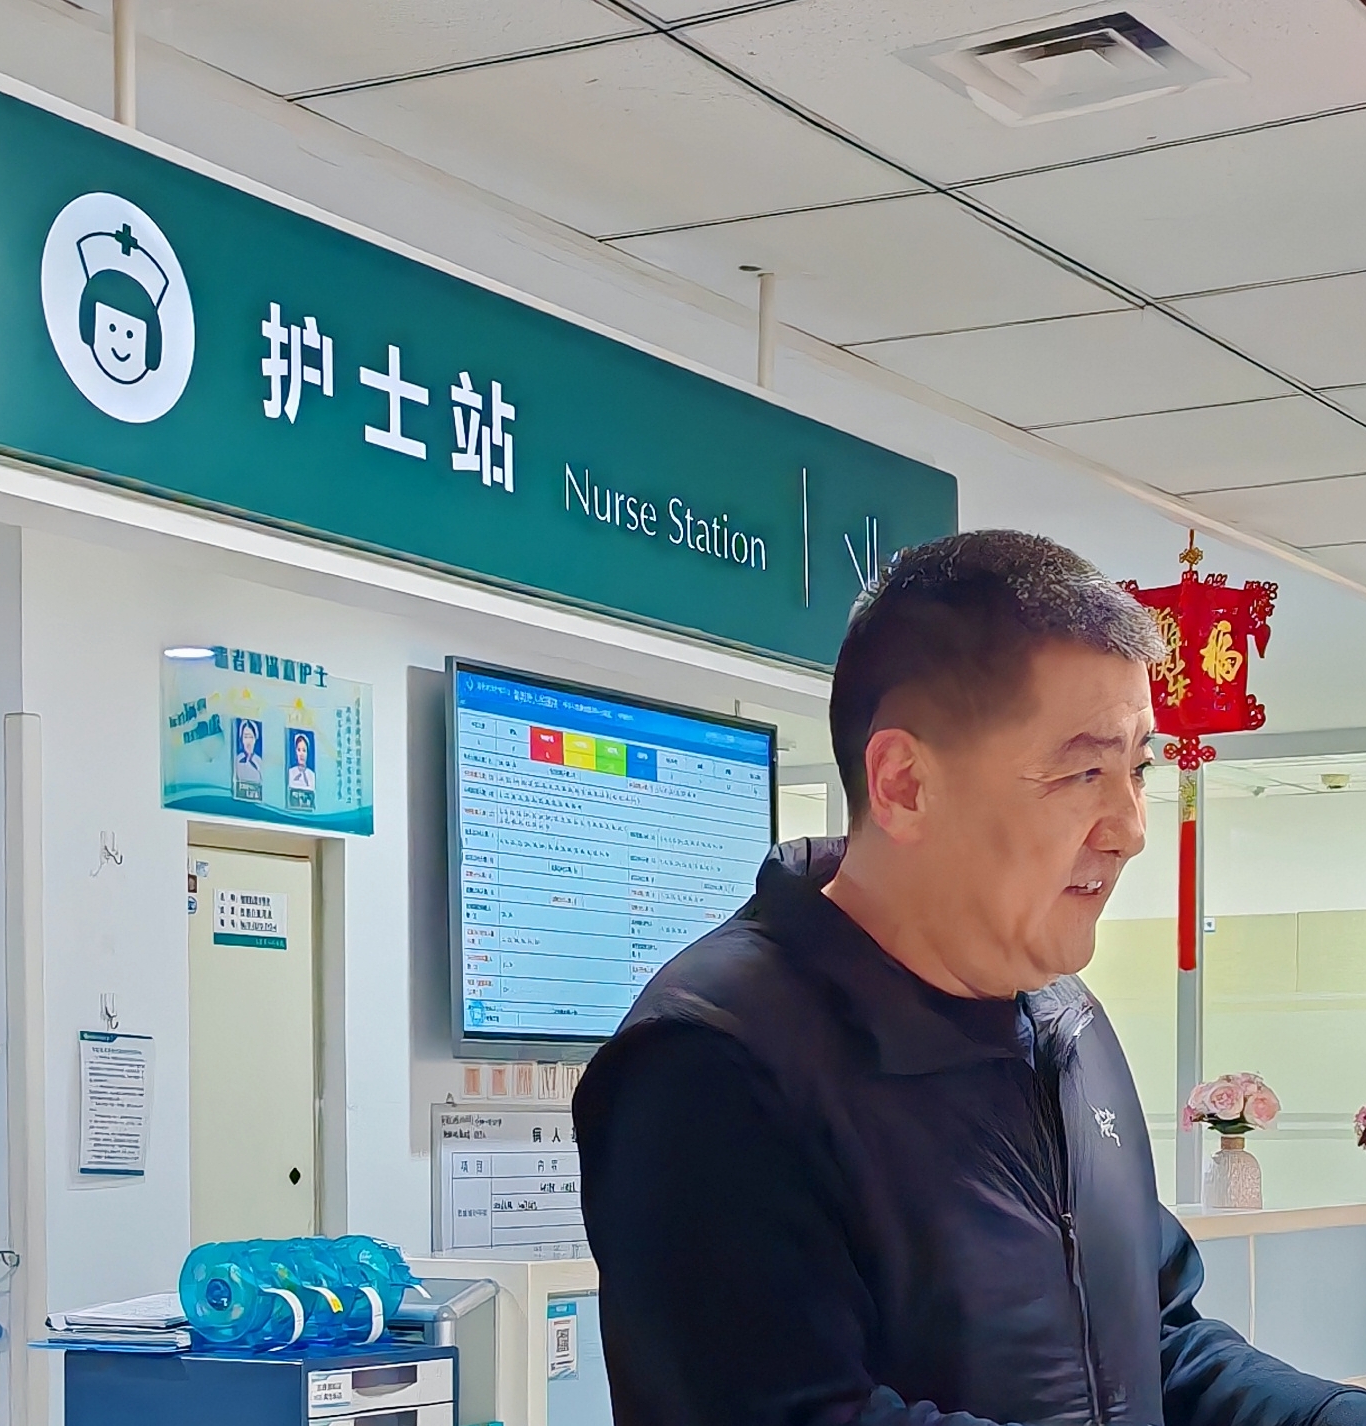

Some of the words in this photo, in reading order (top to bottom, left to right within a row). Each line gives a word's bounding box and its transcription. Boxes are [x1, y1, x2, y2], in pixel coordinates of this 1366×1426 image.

[261, 301, 515, 493] 护士站
[564, 462, 658, 537] Nurse
[667, 497, 767, 571] Station
[1199, 620, 1243, 684] 福
